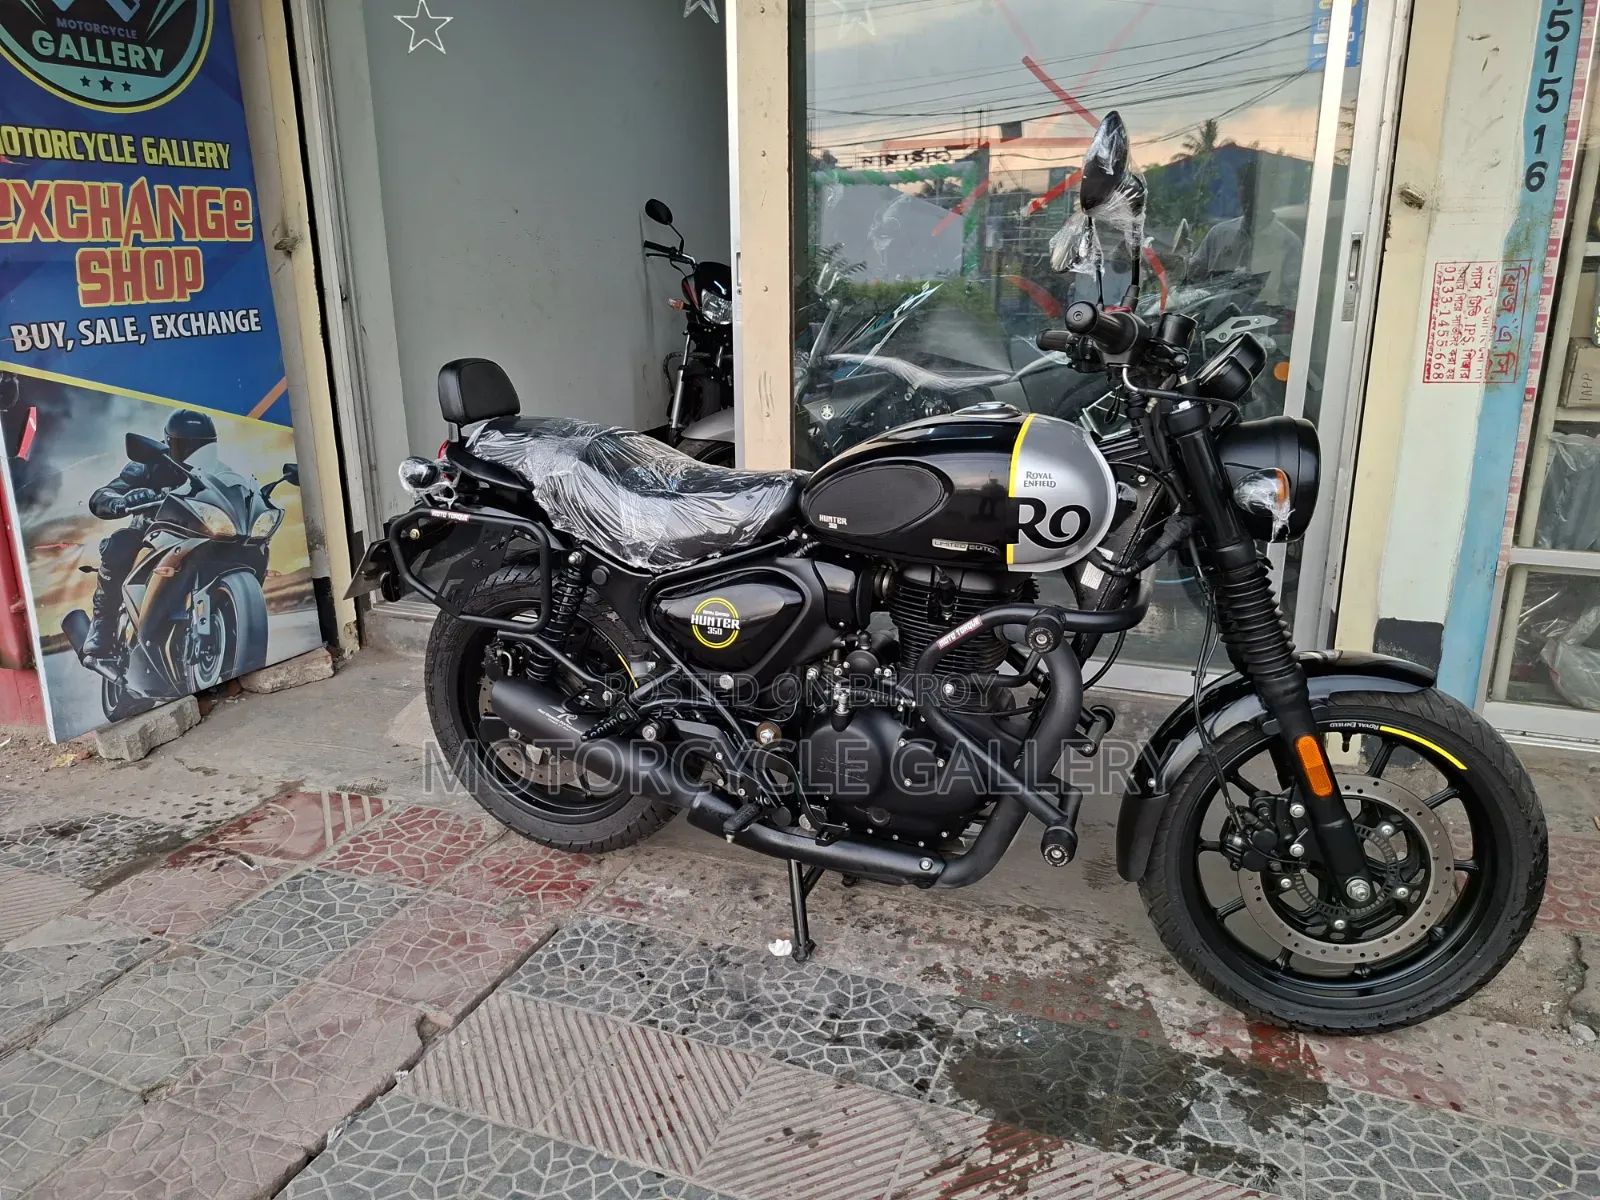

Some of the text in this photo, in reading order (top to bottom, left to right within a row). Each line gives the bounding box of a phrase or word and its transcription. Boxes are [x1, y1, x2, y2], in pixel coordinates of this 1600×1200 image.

[56, 17, 137, 39] MOTORCYCLE
[32, 30, 164, 71] GALLERY
[0, 126, 230, 169] OTORCYCLE GALLERY
[76, 246, 203, 307] SHOP
[10, 309, 262, 352] BUY, SALE, EXCHANGE
[1023, 480, 1057, 488] ENFIELD
[1026, 471, 1053, 479] ROYAL
[819, 514, 847, 525] HUNTER
[691, 614, 740, 630] HUNTER
[707, 626, 723, 635] 350
